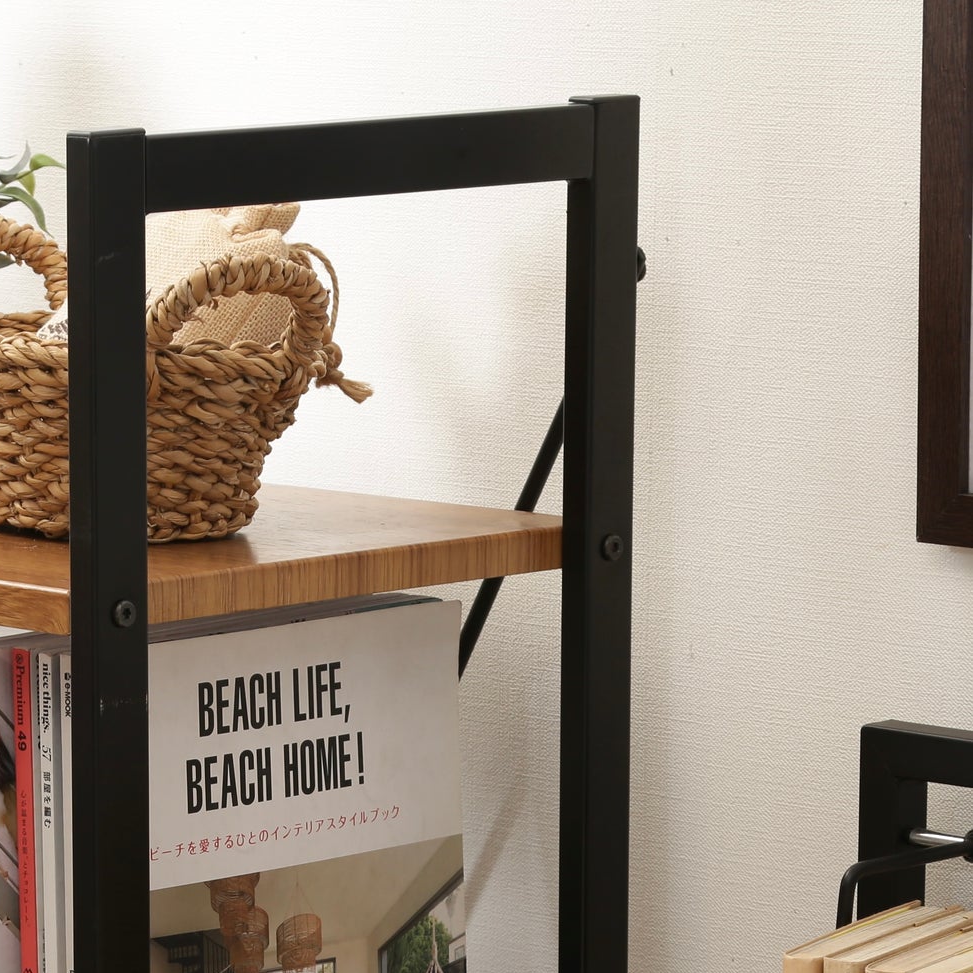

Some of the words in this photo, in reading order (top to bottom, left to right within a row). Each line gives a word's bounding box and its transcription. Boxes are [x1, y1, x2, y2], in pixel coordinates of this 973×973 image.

[42, 663, 51, 689] nice
[198, 671, 282, 737] BEACH
[293, 661, 350, 723] LIFE,
[17, 730, 27, 752] 49
[41, 745, 51, 762] 57
[186, 747, 272, 814] BEACH
[150, 805, 401, 861] ビーチを愛するひとのインテリアスタイルブック
